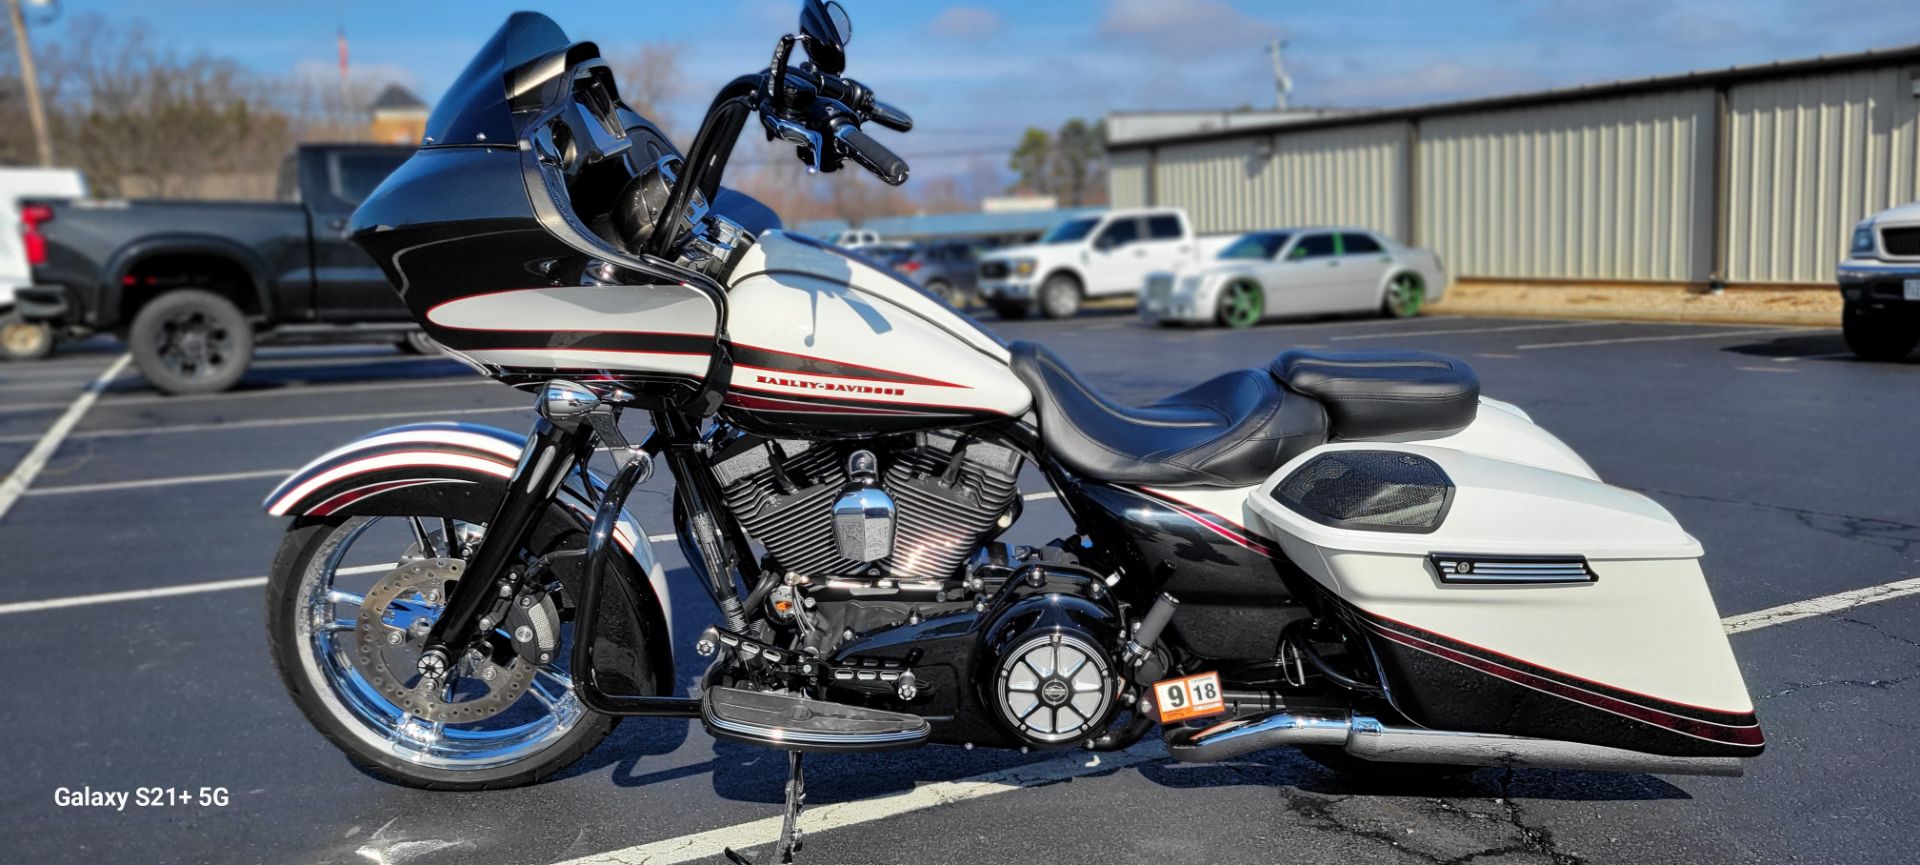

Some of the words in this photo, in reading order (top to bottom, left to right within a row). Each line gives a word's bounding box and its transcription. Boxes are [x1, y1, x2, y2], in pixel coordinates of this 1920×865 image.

[756, 375, 905, 396] HARLEY-DAVIDSON
[1168, 685, 1185, 707] 9
[1193, 683, 1216, 701] 18
